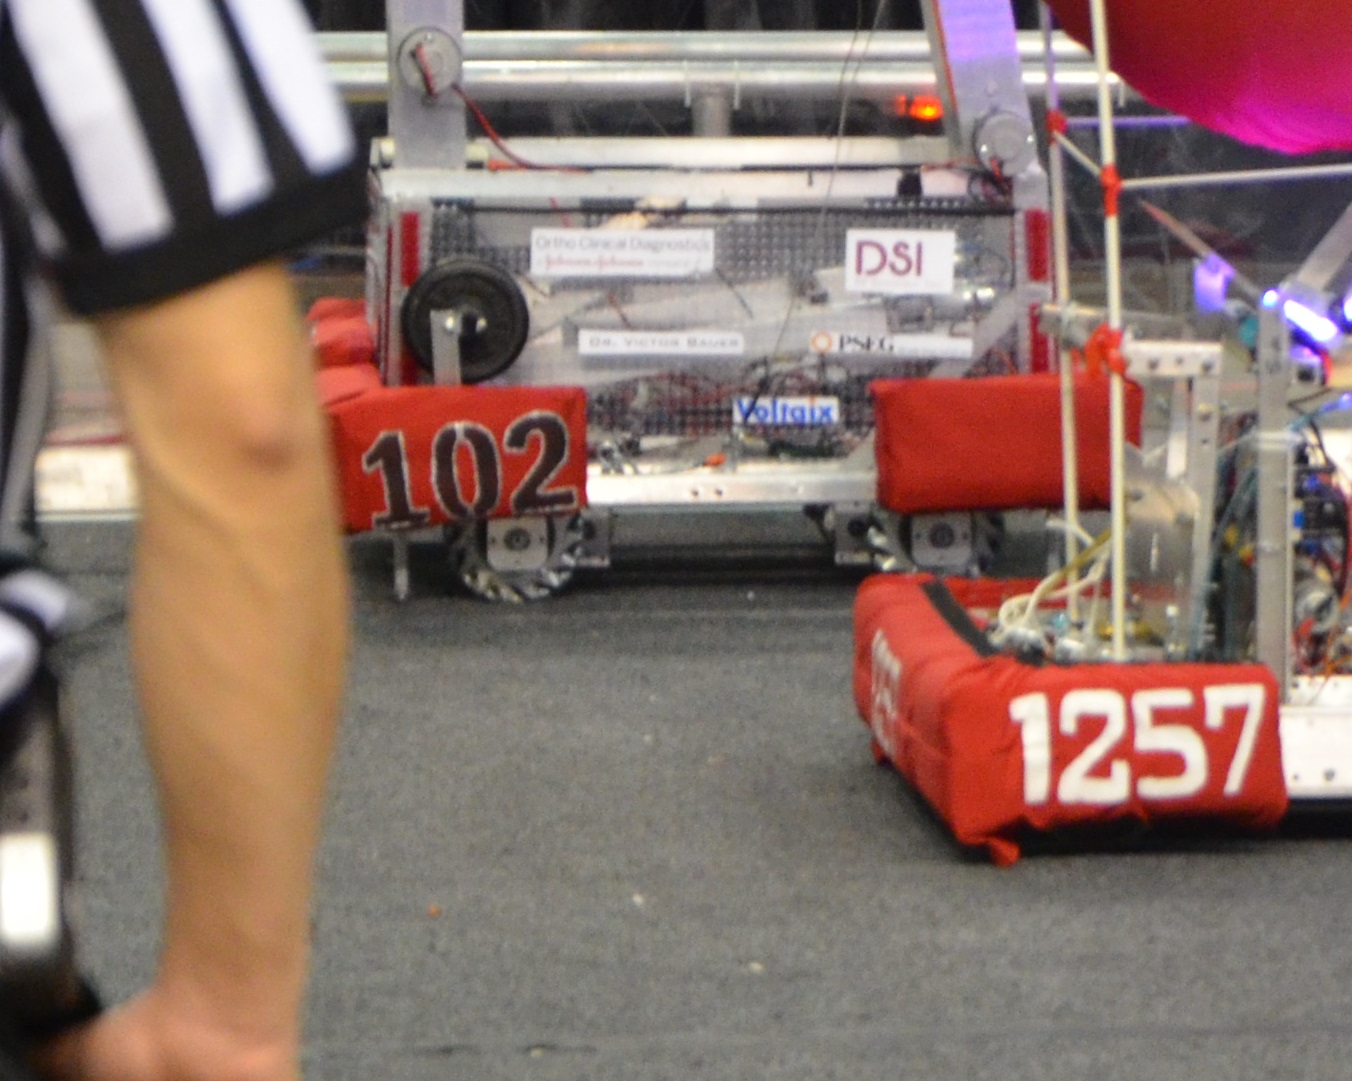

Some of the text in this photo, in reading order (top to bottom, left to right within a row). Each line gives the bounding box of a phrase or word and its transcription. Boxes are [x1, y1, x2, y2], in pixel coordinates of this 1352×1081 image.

[535, 235, 711, 253] Ortho Clinical Diagnostics
[854, 239, 923, 277] DSI
[839, 333, 894, 352] PSEG
[361, 409, 580, 529] 102
[1008, 683, 1266, 805] 1257
